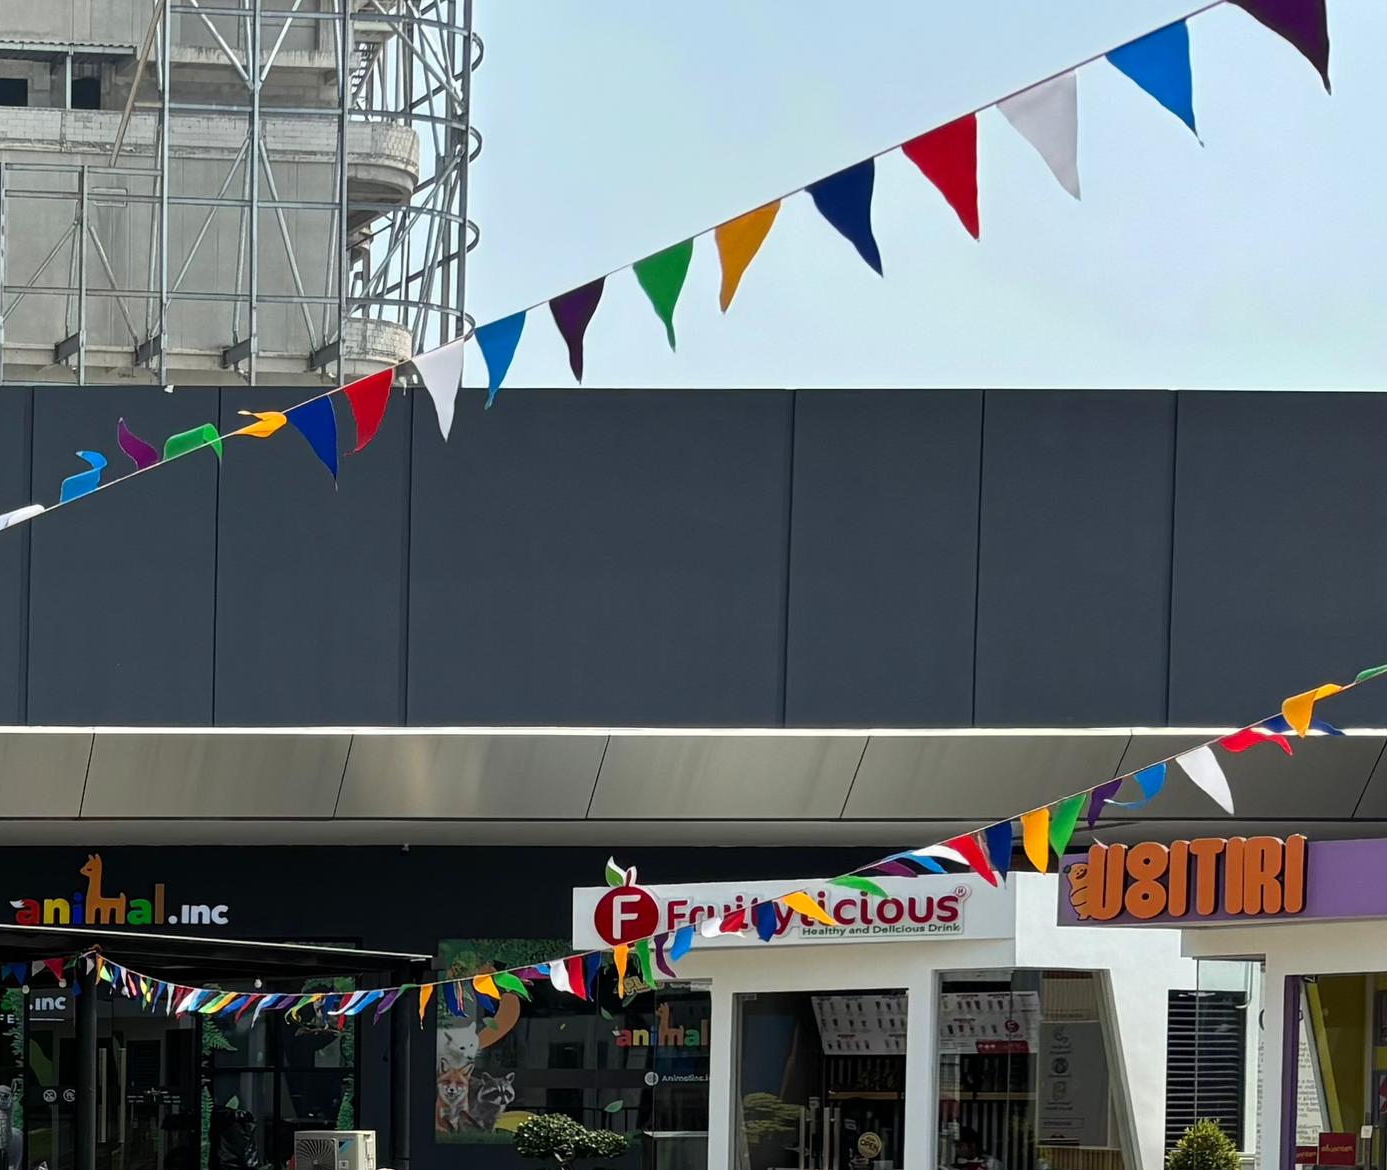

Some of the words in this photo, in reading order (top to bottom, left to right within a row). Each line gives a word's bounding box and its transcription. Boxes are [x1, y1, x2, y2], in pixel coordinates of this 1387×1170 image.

[10, 854, 229, 925] animal.inc
[802, 927, 846, 936] Healthy
[849, 925, 870, 934] and
[873, 924, 925, 934] Delicious
[928, 923, 961, 932] Drink
